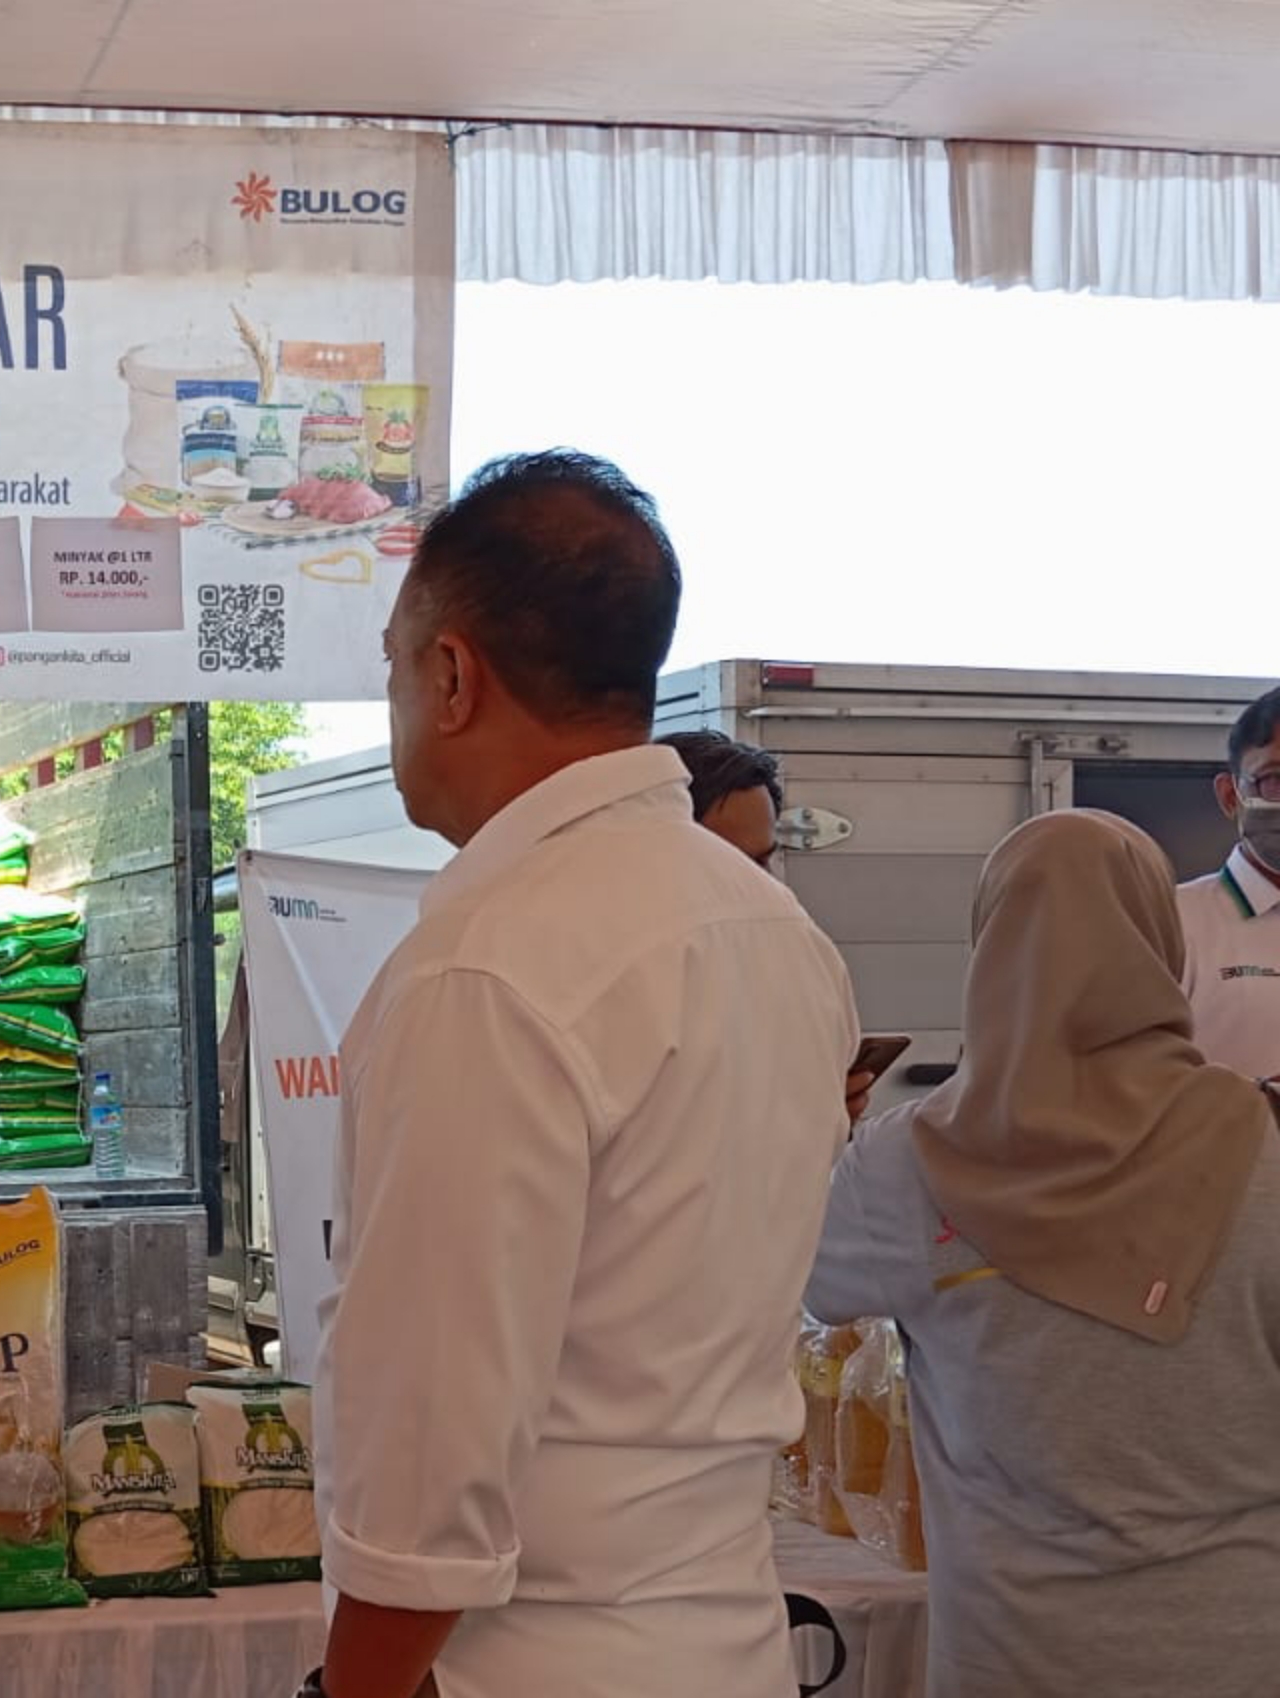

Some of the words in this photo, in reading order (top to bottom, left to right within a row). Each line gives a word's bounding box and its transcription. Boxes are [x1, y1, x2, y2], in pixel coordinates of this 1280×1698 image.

[280, 189, 407, 215] BULOG
[53, 551, 105, 563] MINYAK
[131, 551, 153, 563] LTR
[59, 571, 85, 586] RP.
[87, 570, 150, 587] 14.000,-
